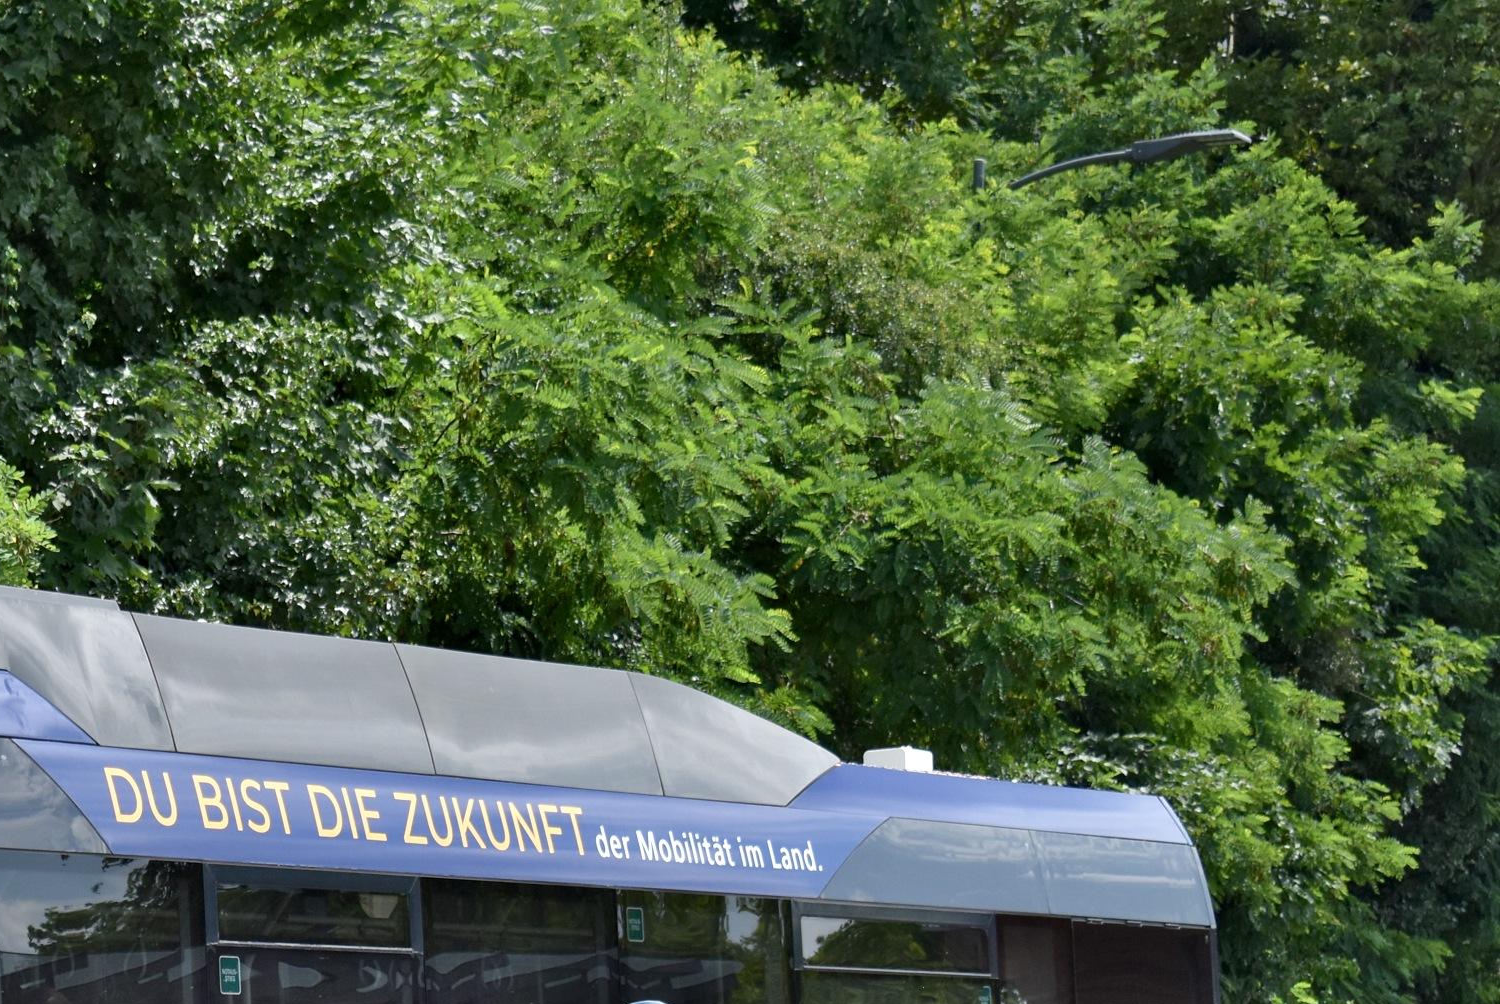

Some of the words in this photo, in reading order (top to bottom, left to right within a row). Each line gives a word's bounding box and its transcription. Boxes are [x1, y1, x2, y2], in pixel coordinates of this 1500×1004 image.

[104, 767, 178, 828] DU
[192, 774, 290, 835] BIST
[306, 784, 388, 842] DIE
[393, 792, 585, 856] ZUKUNFT
[595, 825, 631, 860] der
[637, 829, 736, 867] Mobilität
[737, 836, 765, 868] im
[769, 838, 824, 872] Land.
